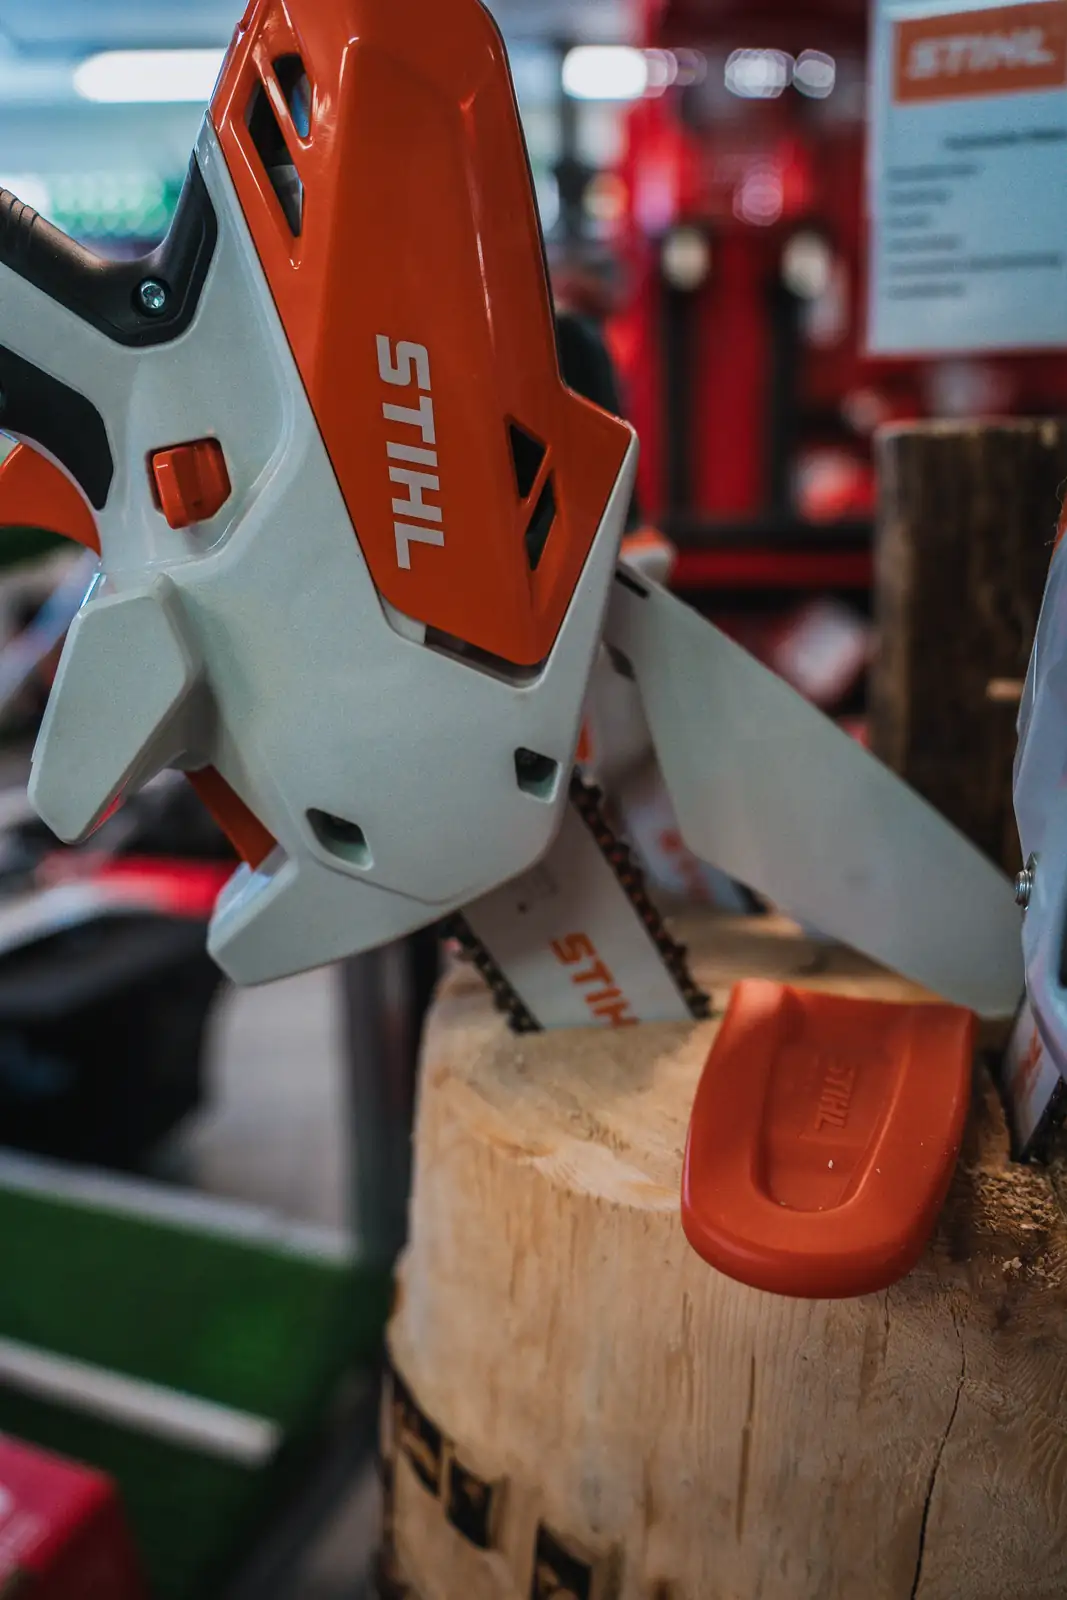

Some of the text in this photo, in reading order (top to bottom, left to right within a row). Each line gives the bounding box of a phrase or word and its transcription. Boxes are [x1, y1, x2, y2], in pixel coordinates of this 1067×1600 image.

[376, 334, 445, 570] STIHL
[550, 932, 640, 1029] STIH
[814, 1056, 857, 1131] STIHL
